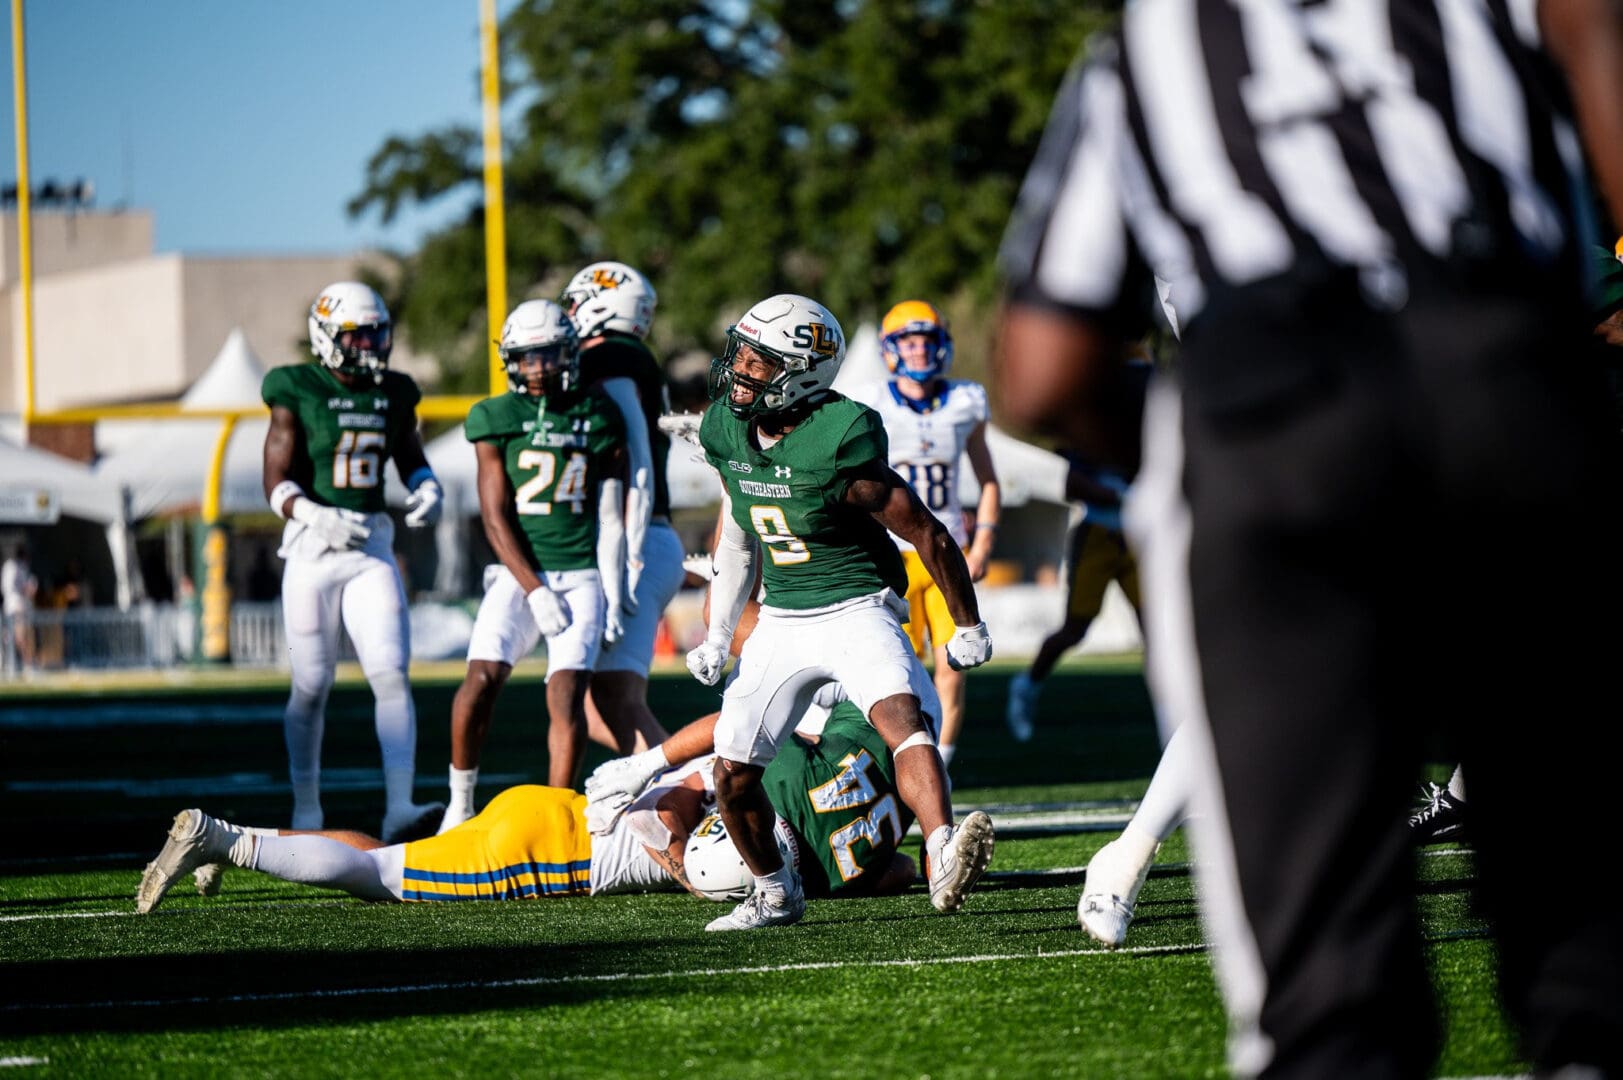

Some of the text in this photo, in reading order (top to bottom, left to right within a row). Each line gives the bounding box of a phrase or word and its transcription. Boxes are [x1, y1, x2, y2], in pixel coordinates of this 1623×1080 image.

[739, 322, 759, 336] Riddell
[332, 430, 387, 489] 16
[515, 449, 587, 515] 24
[738, 479, 792, 499] SOUTHEASTERN
[749, 505, 812, 565] 9
[808, 748, 903, 882] 34
